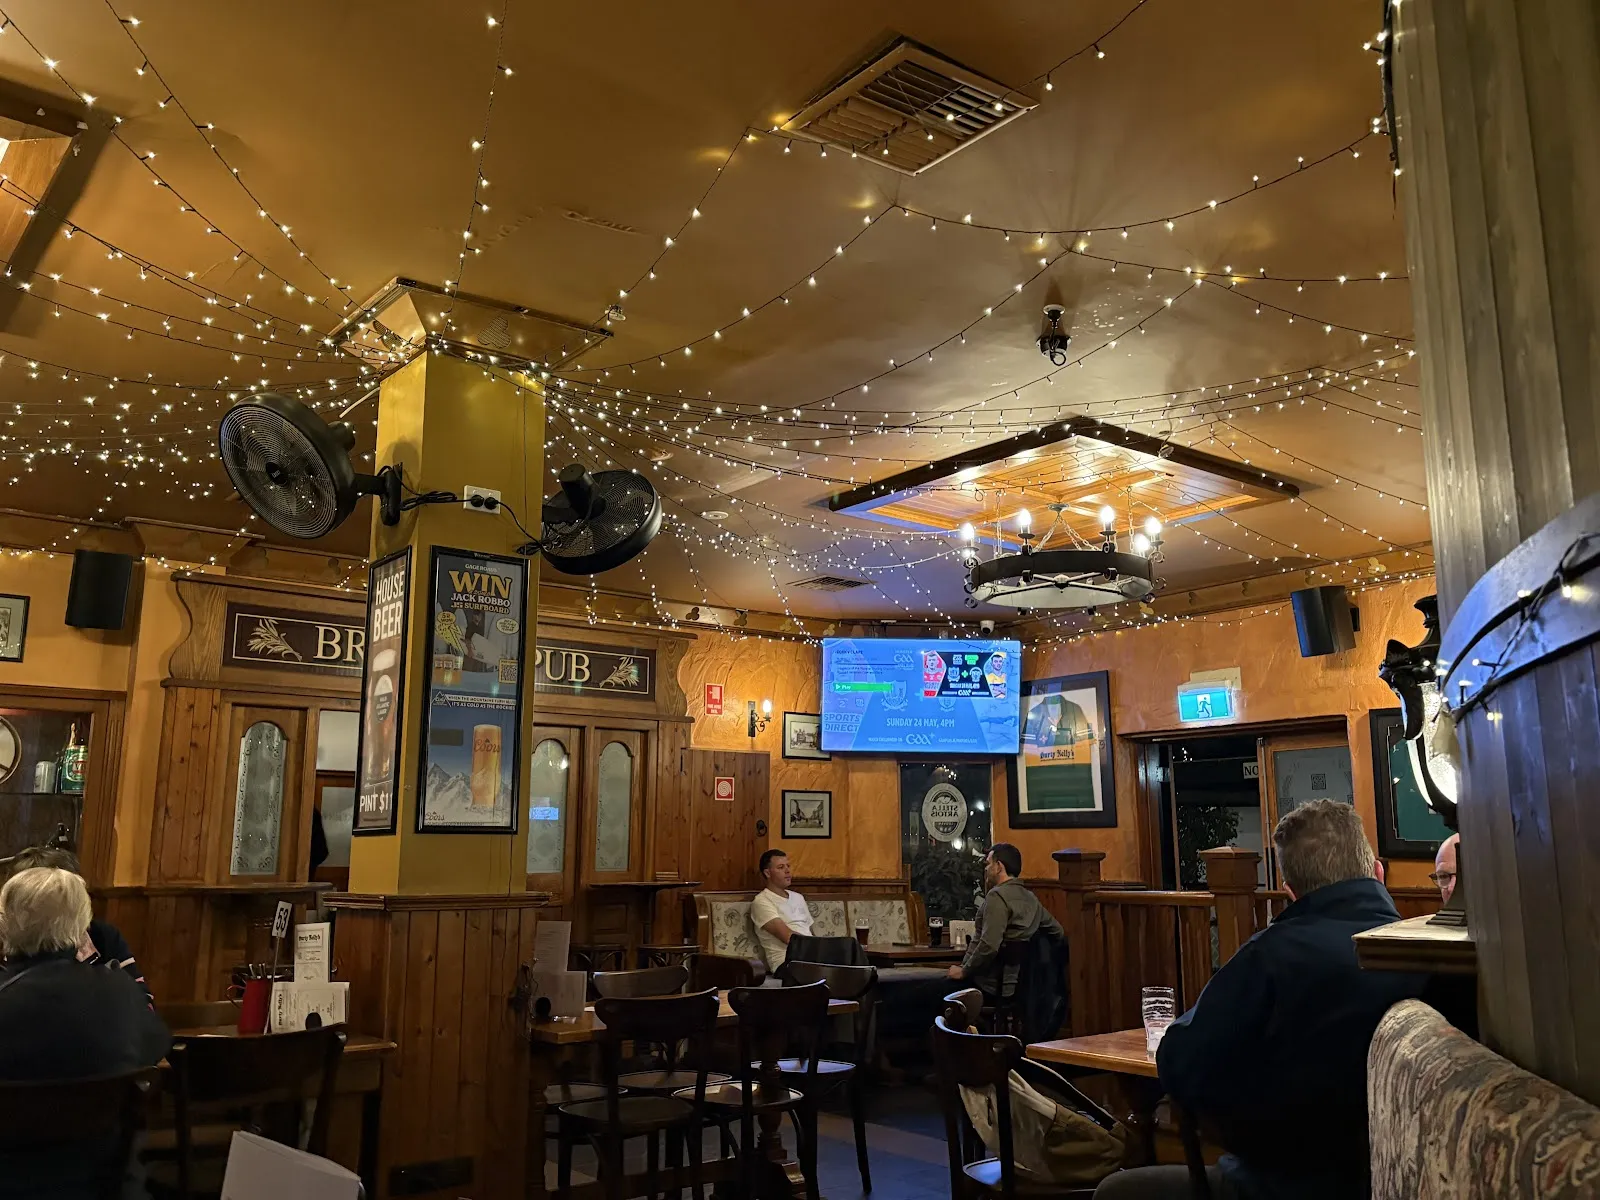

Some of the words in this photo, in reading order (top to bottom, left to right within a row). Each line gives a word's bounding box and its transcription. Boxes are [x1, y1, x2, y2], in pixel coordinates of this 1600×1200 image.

[375, 571, 405, 606] HOUSE
[449, 570, 512, 599] WIN
[451, 593, 477, 603] JACK
[478, 595, 511, 608] ROBBO
[464, 602, 510, 615] SURFBOARD
[373, 601, 403, 642] BEER
[823, 713, 861, 722] SPORTS
[886, 717, 912, 727] SUNDAY
[940, 718, 955, 728] 4PM
[825, 723, 860, 732] DIRECT
[360, 793, 379, 812] PINT
[275, 907, 289, 931] 53
